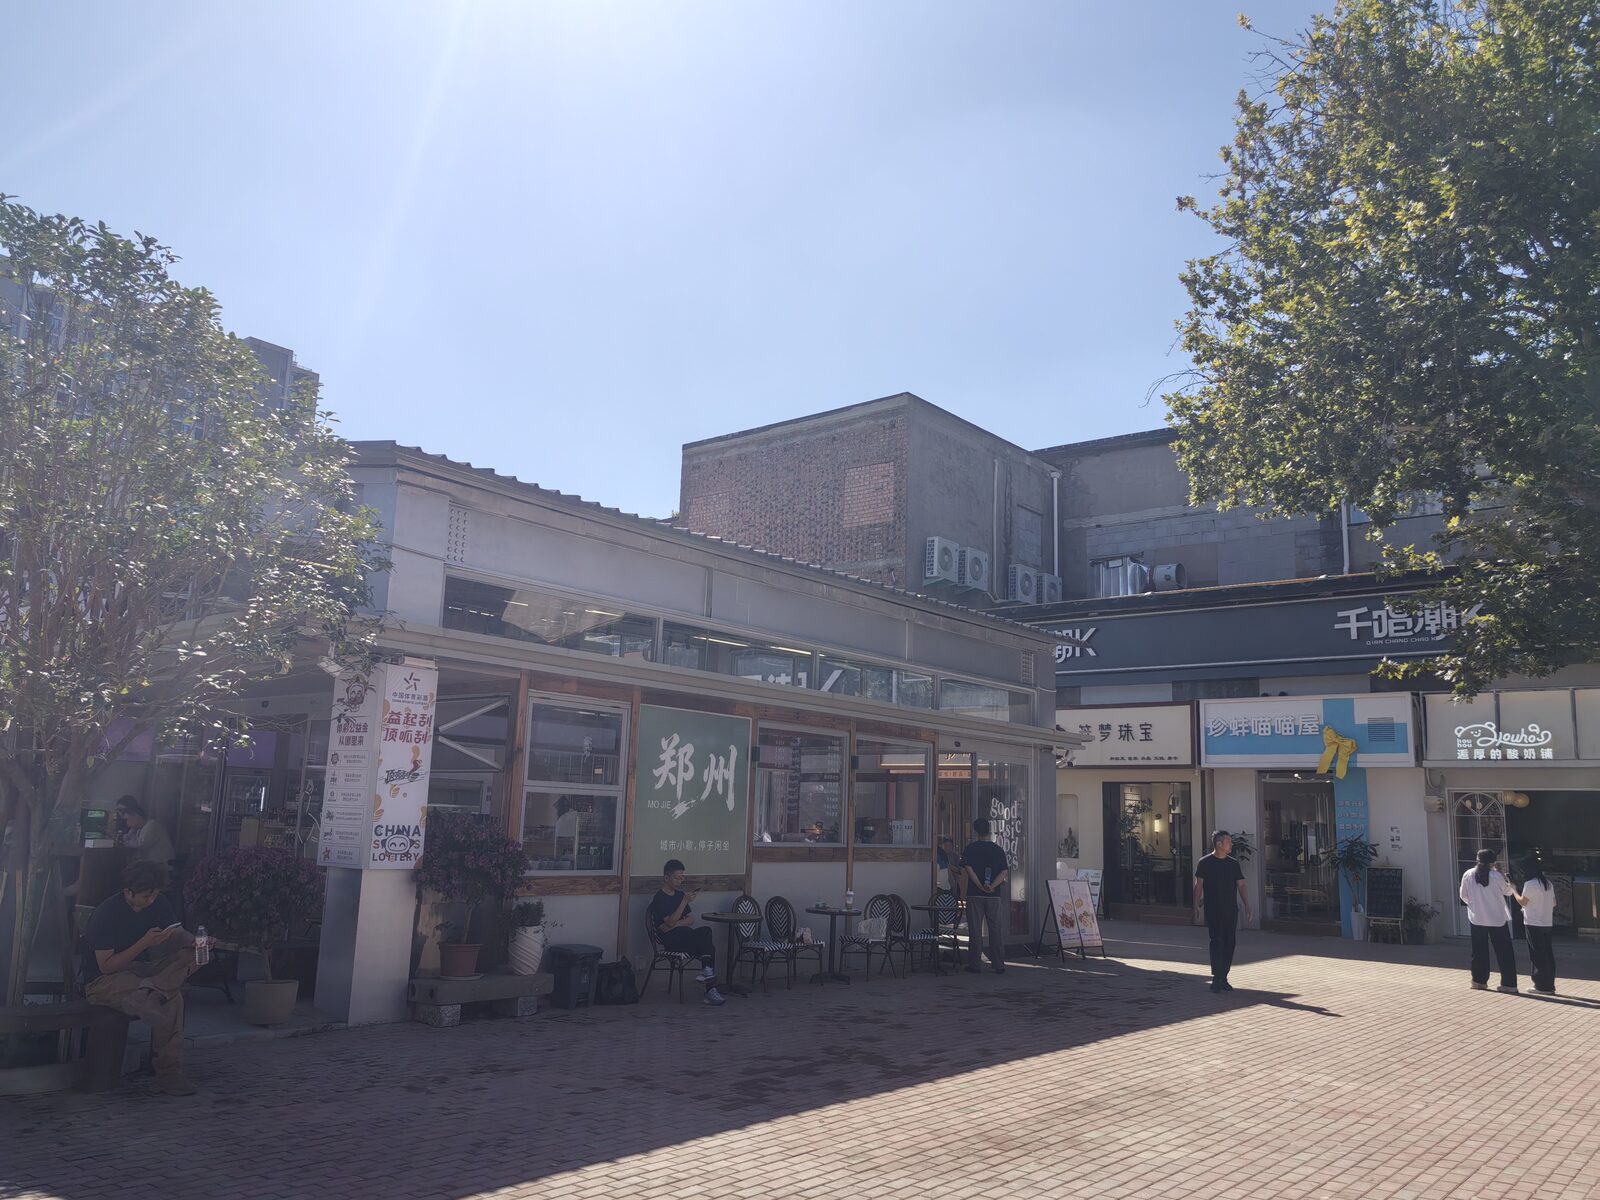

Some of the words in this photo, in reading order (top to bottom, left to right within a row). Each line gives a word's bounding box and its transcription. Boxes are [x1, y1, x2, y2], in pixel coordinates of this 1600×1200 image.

[392, 691, 429, 702] 中国体育彩票
[387, 710, 433, 727] 益起刮
[336, 722, 369, 734] 体彩公益金
[1207, 714, 1320, 737] 珍蚌喵喵屋
[338, 735, 364, 746] 从哪里来
[382, 727, 430, 744] 顶呱刮
[652, 732, 738, 820] 郑州
[647, 799, 660, 809] MO
[660, 800, 672, 810] JIE
[990, 797, 1018, 820] good
[374, 825, 421, 837] CHINA
[372, 852, 420, 862] LOTTERY
